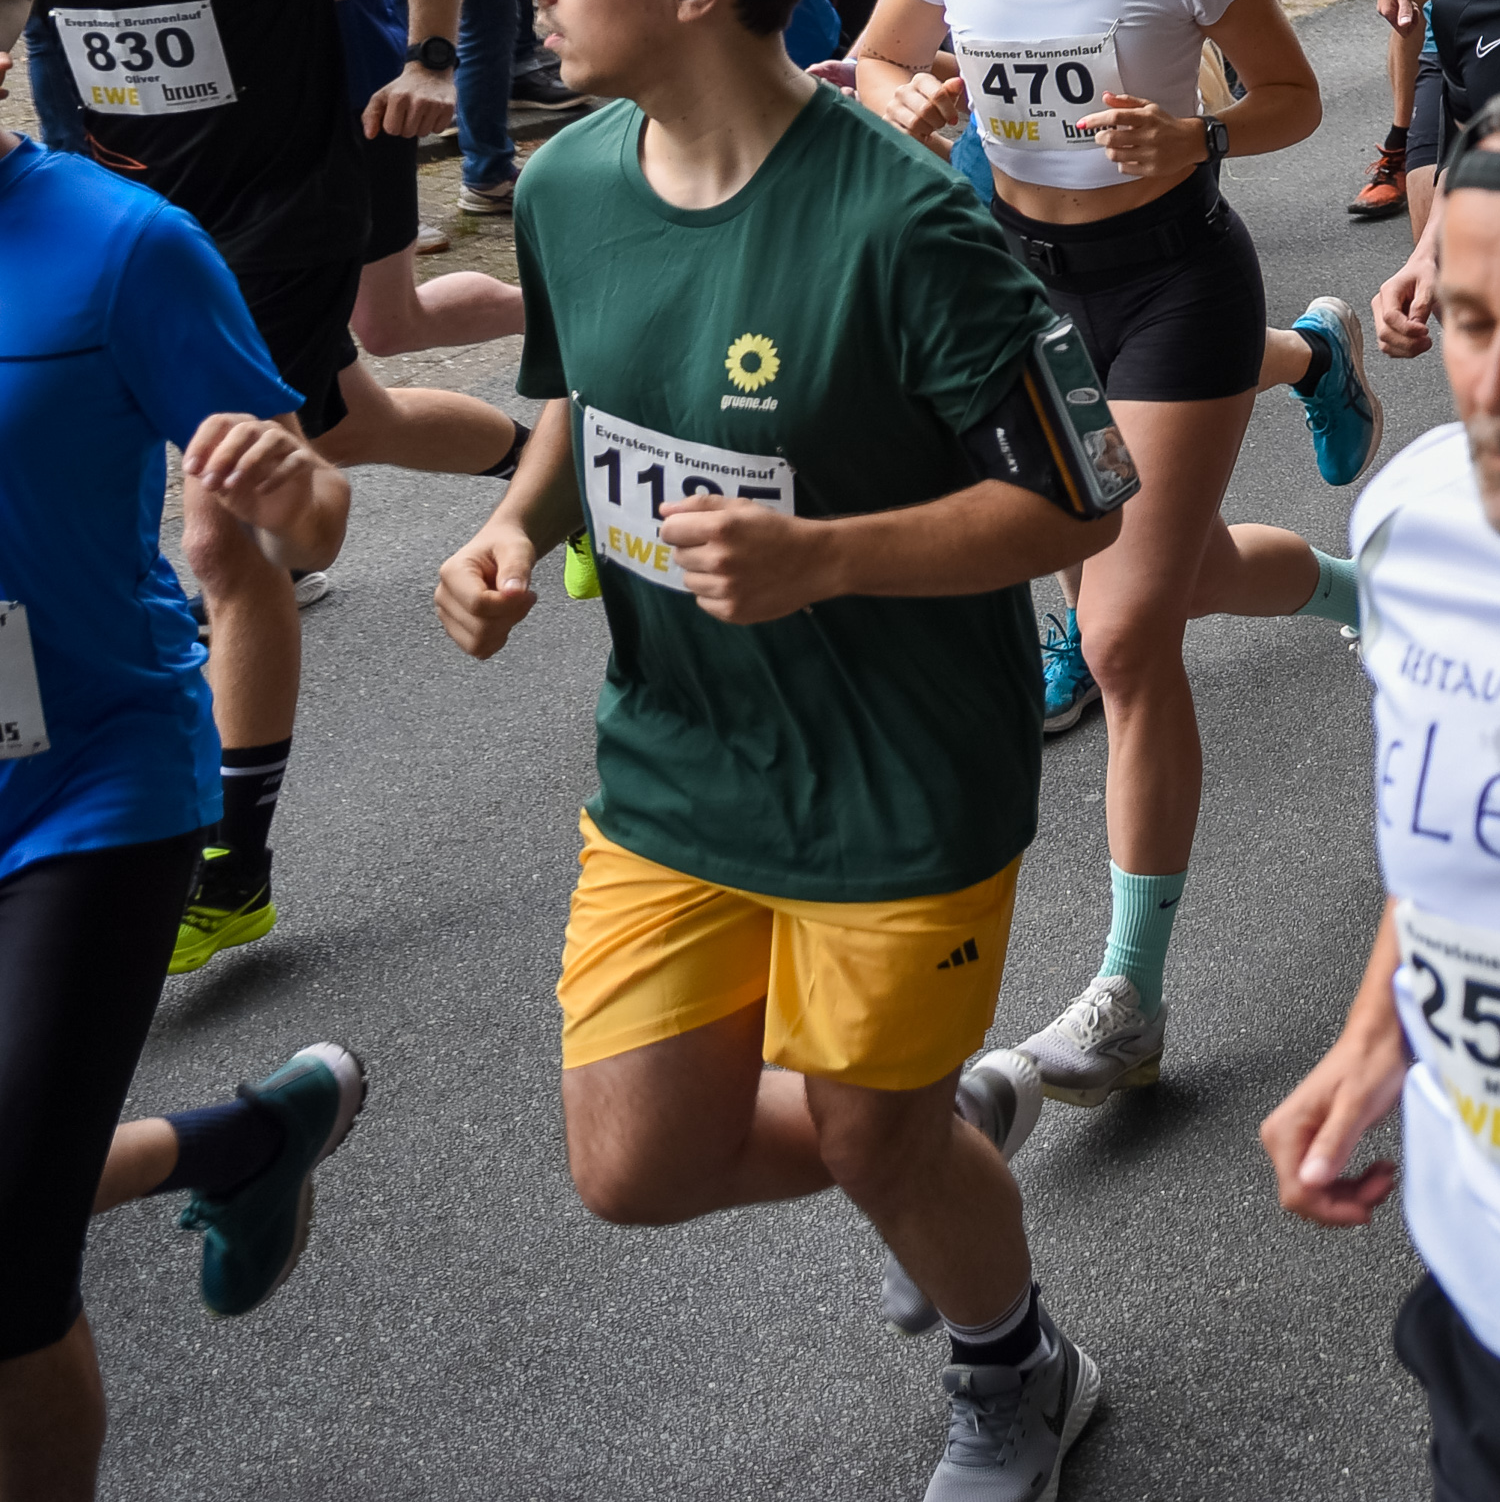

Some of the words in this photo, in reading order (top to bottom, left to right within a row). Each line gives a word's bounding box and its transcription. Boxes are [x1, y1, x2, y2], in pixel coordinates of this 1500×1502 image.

[65, 18, 120, 28] Everstener
[123, 11, 202, 28] Brunnenlauf
[82, 27, 195, 72] 830
[962, 46, 1022, 59] Everstener
[1025, 43, 1103, 60] Brunnenlauf
[125, 74, 160, 84] Oliver
[982, 61, 1095, 105] 470
[91, 86, 140, 106] EWE
[162, 81, 218, 102] bruns
[1029, 108, 1057, 118] Lara
[989, 117, 1040, 141] EWE
[720, 394, 779, 411] gruene.de
[595, 425, 671, 460] Everstener
[674, 451, 775, 480] Brunnenlauf
[593, 447, 782, 521] 11
[608, 526, 672, 573] EWE
